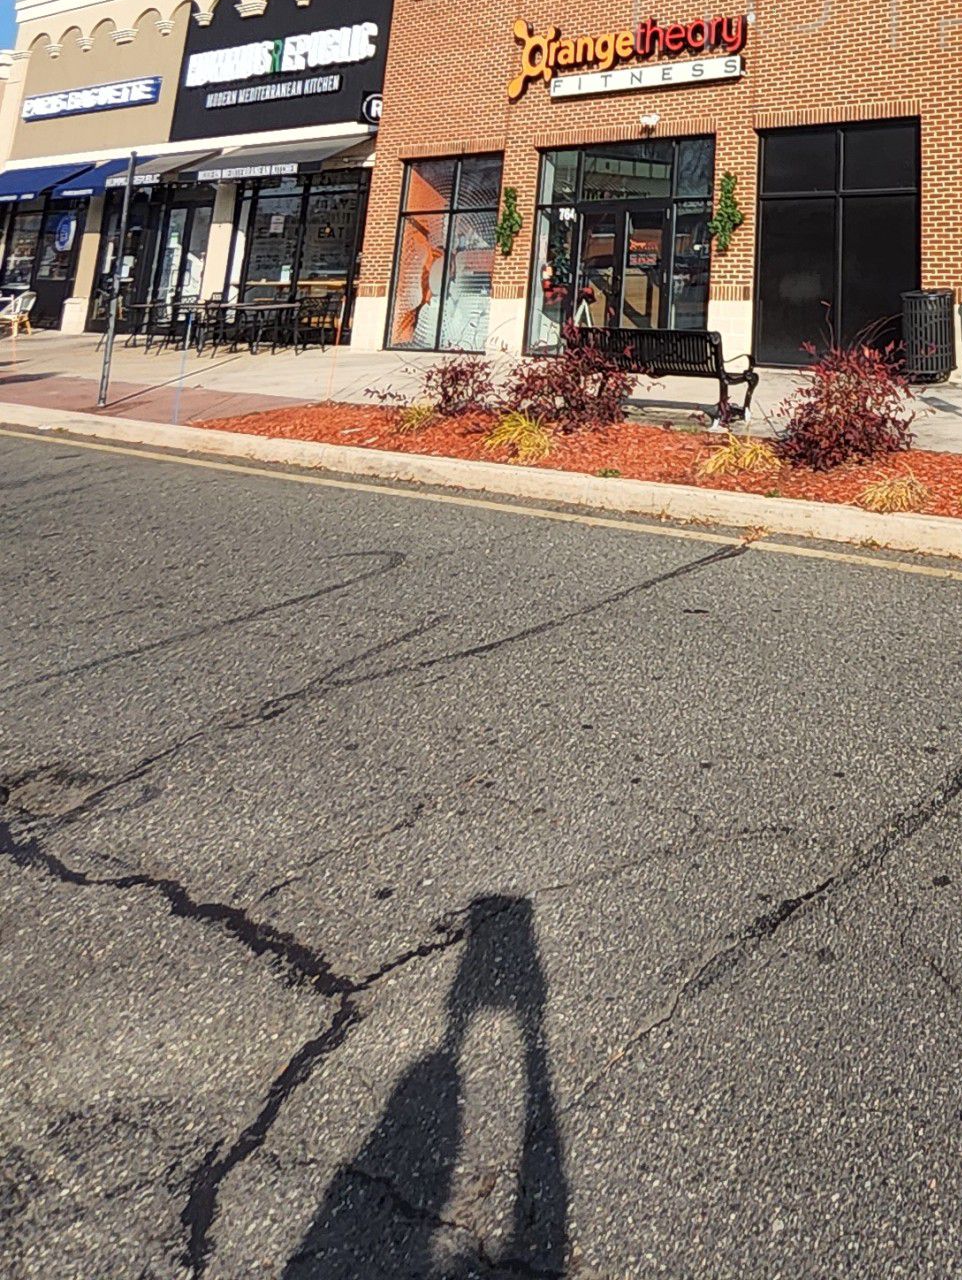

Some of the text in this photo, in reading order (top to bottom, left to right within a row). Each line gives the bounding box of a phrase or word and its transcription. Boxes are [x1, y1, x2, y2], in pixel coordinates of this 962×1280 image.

[206, 74, 341, 109] MODERN MEDITERRANEAN KITCHEN
[553, 59, 738, 94] FITNESS
